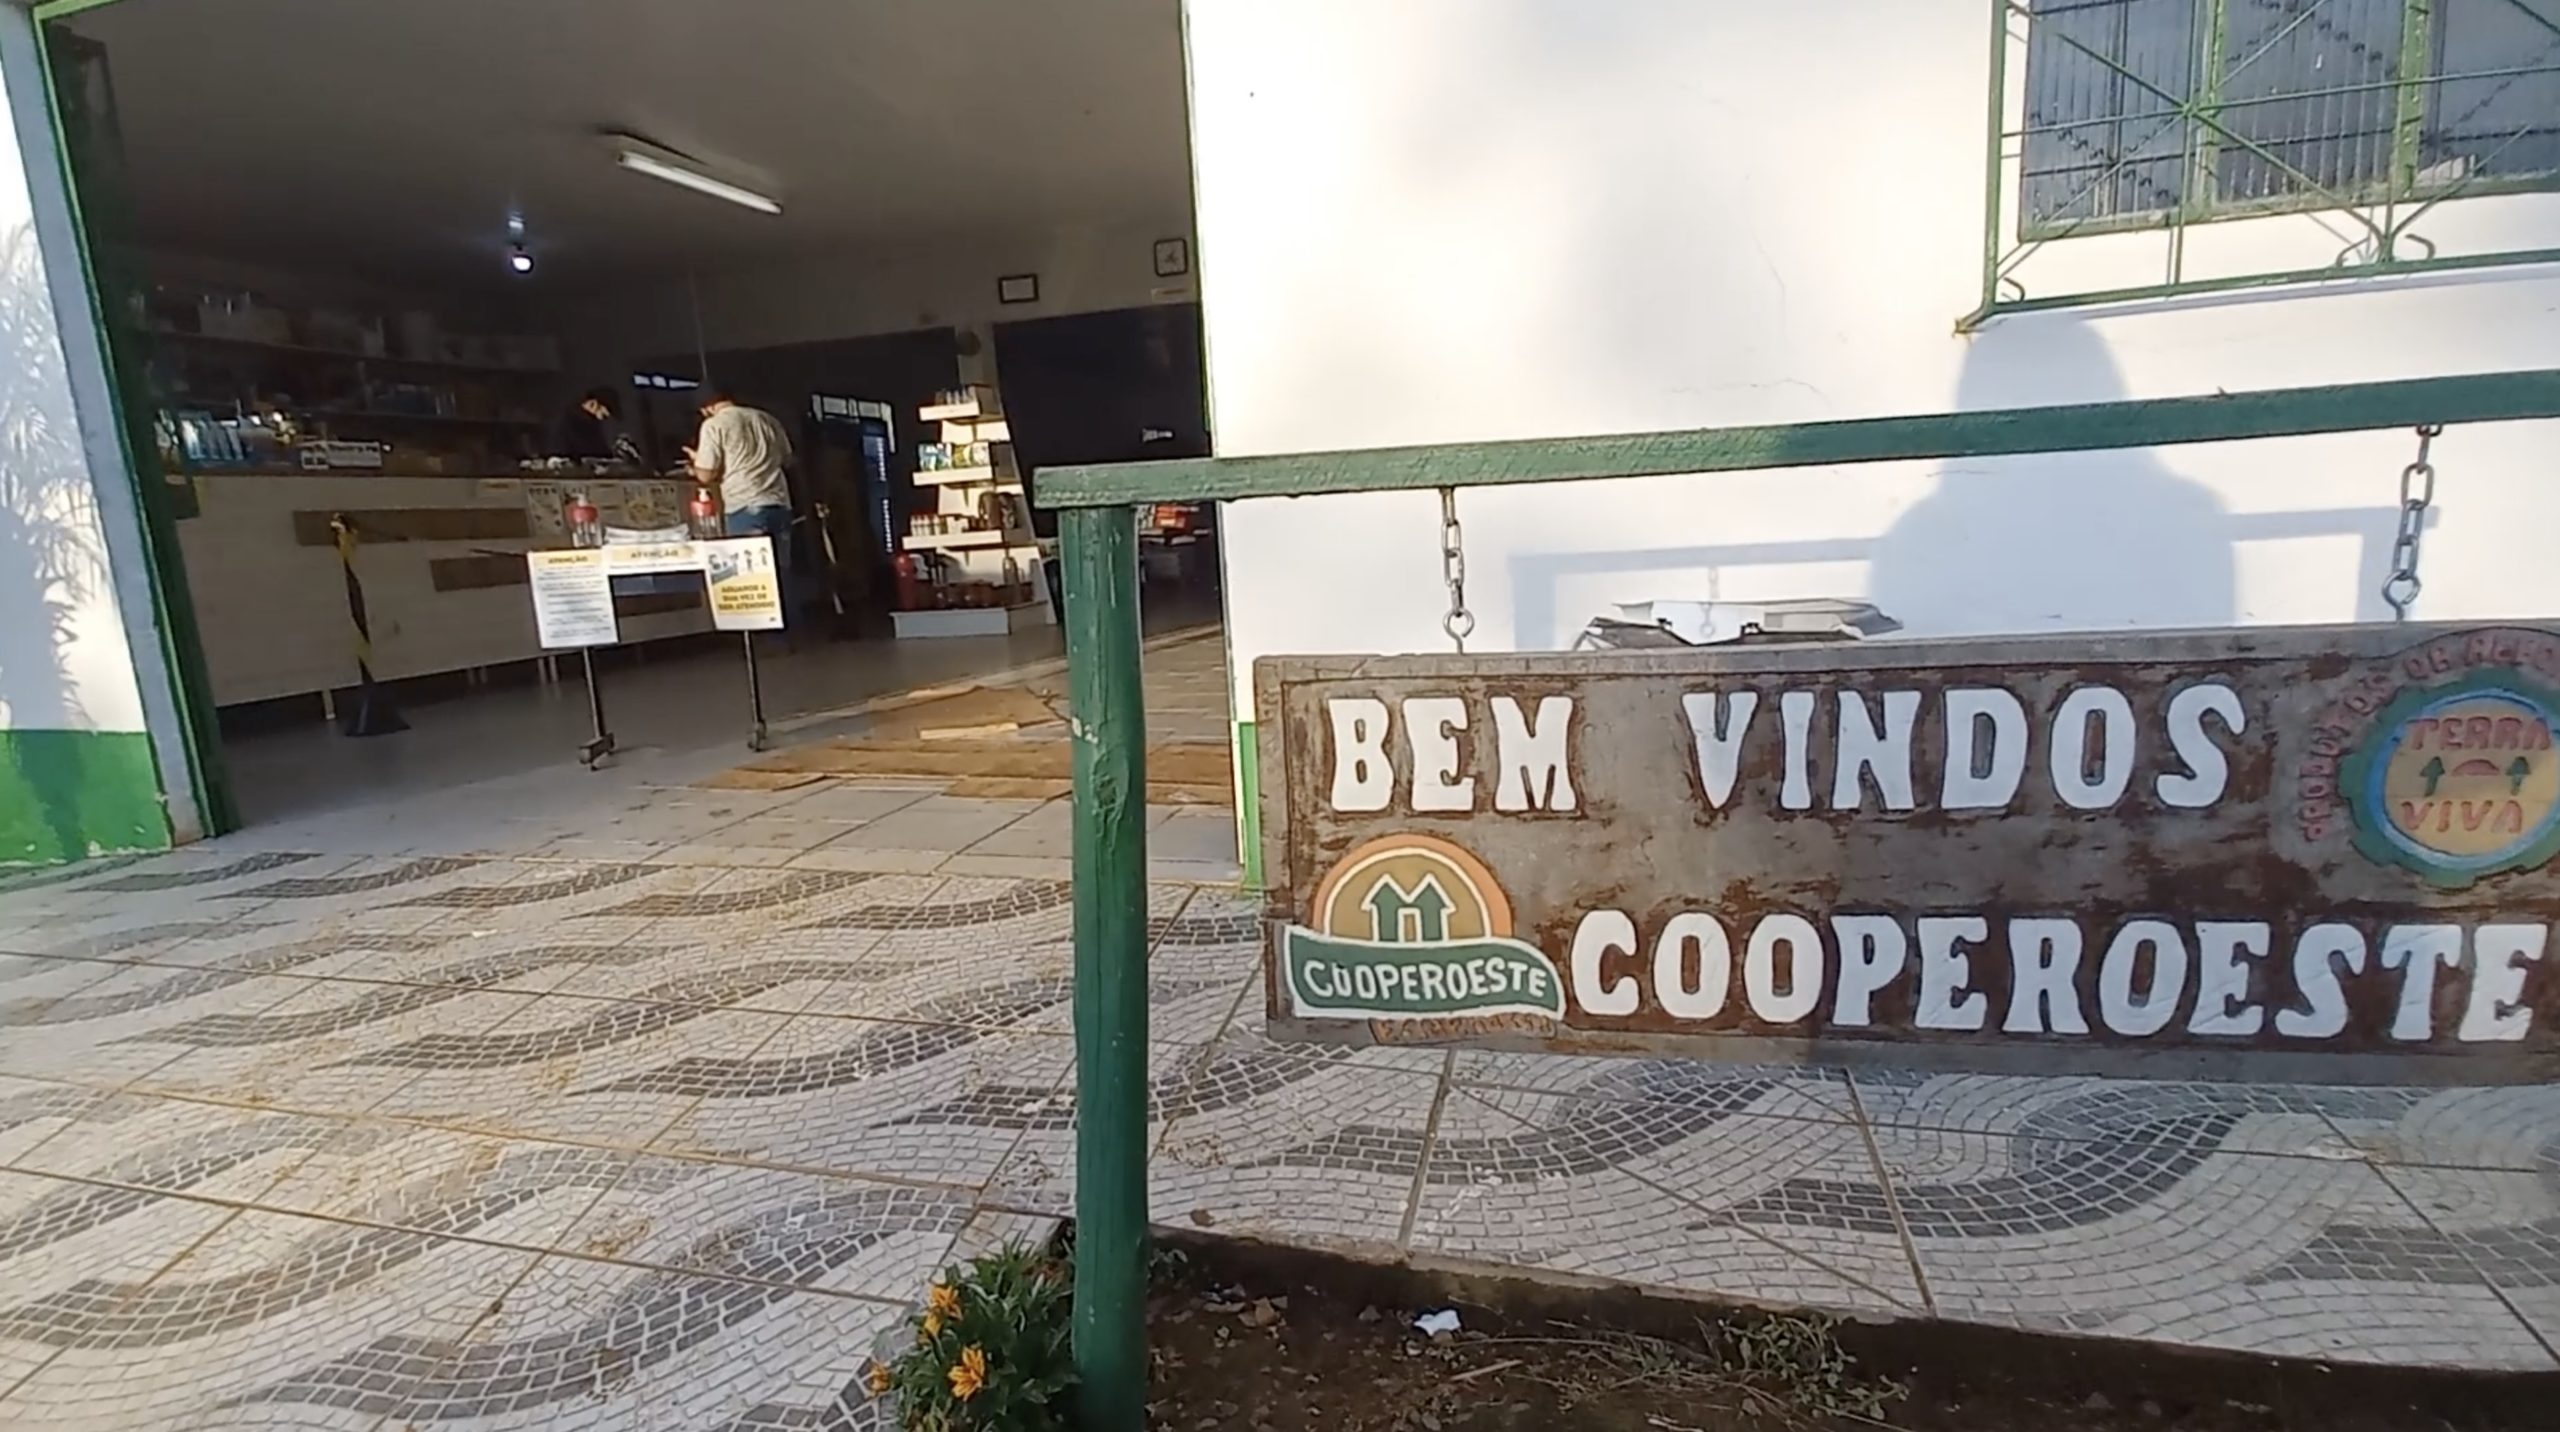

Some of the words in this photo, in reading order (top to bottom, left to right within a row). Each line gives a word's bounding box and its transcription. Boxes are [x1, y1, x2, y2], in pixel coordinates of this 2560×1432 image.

[1328, 697, 1577, 812] BEM
[1681, 685, 2245, 810] VINDOS
[2406, 716, 2551, 750] TERRA
[2402, 798, 2523, 833] VIVA
[1303, 957, 1547, 1001] COOPEROESTE
[1571, 910, 2547, 1041] COOPEROESTE
